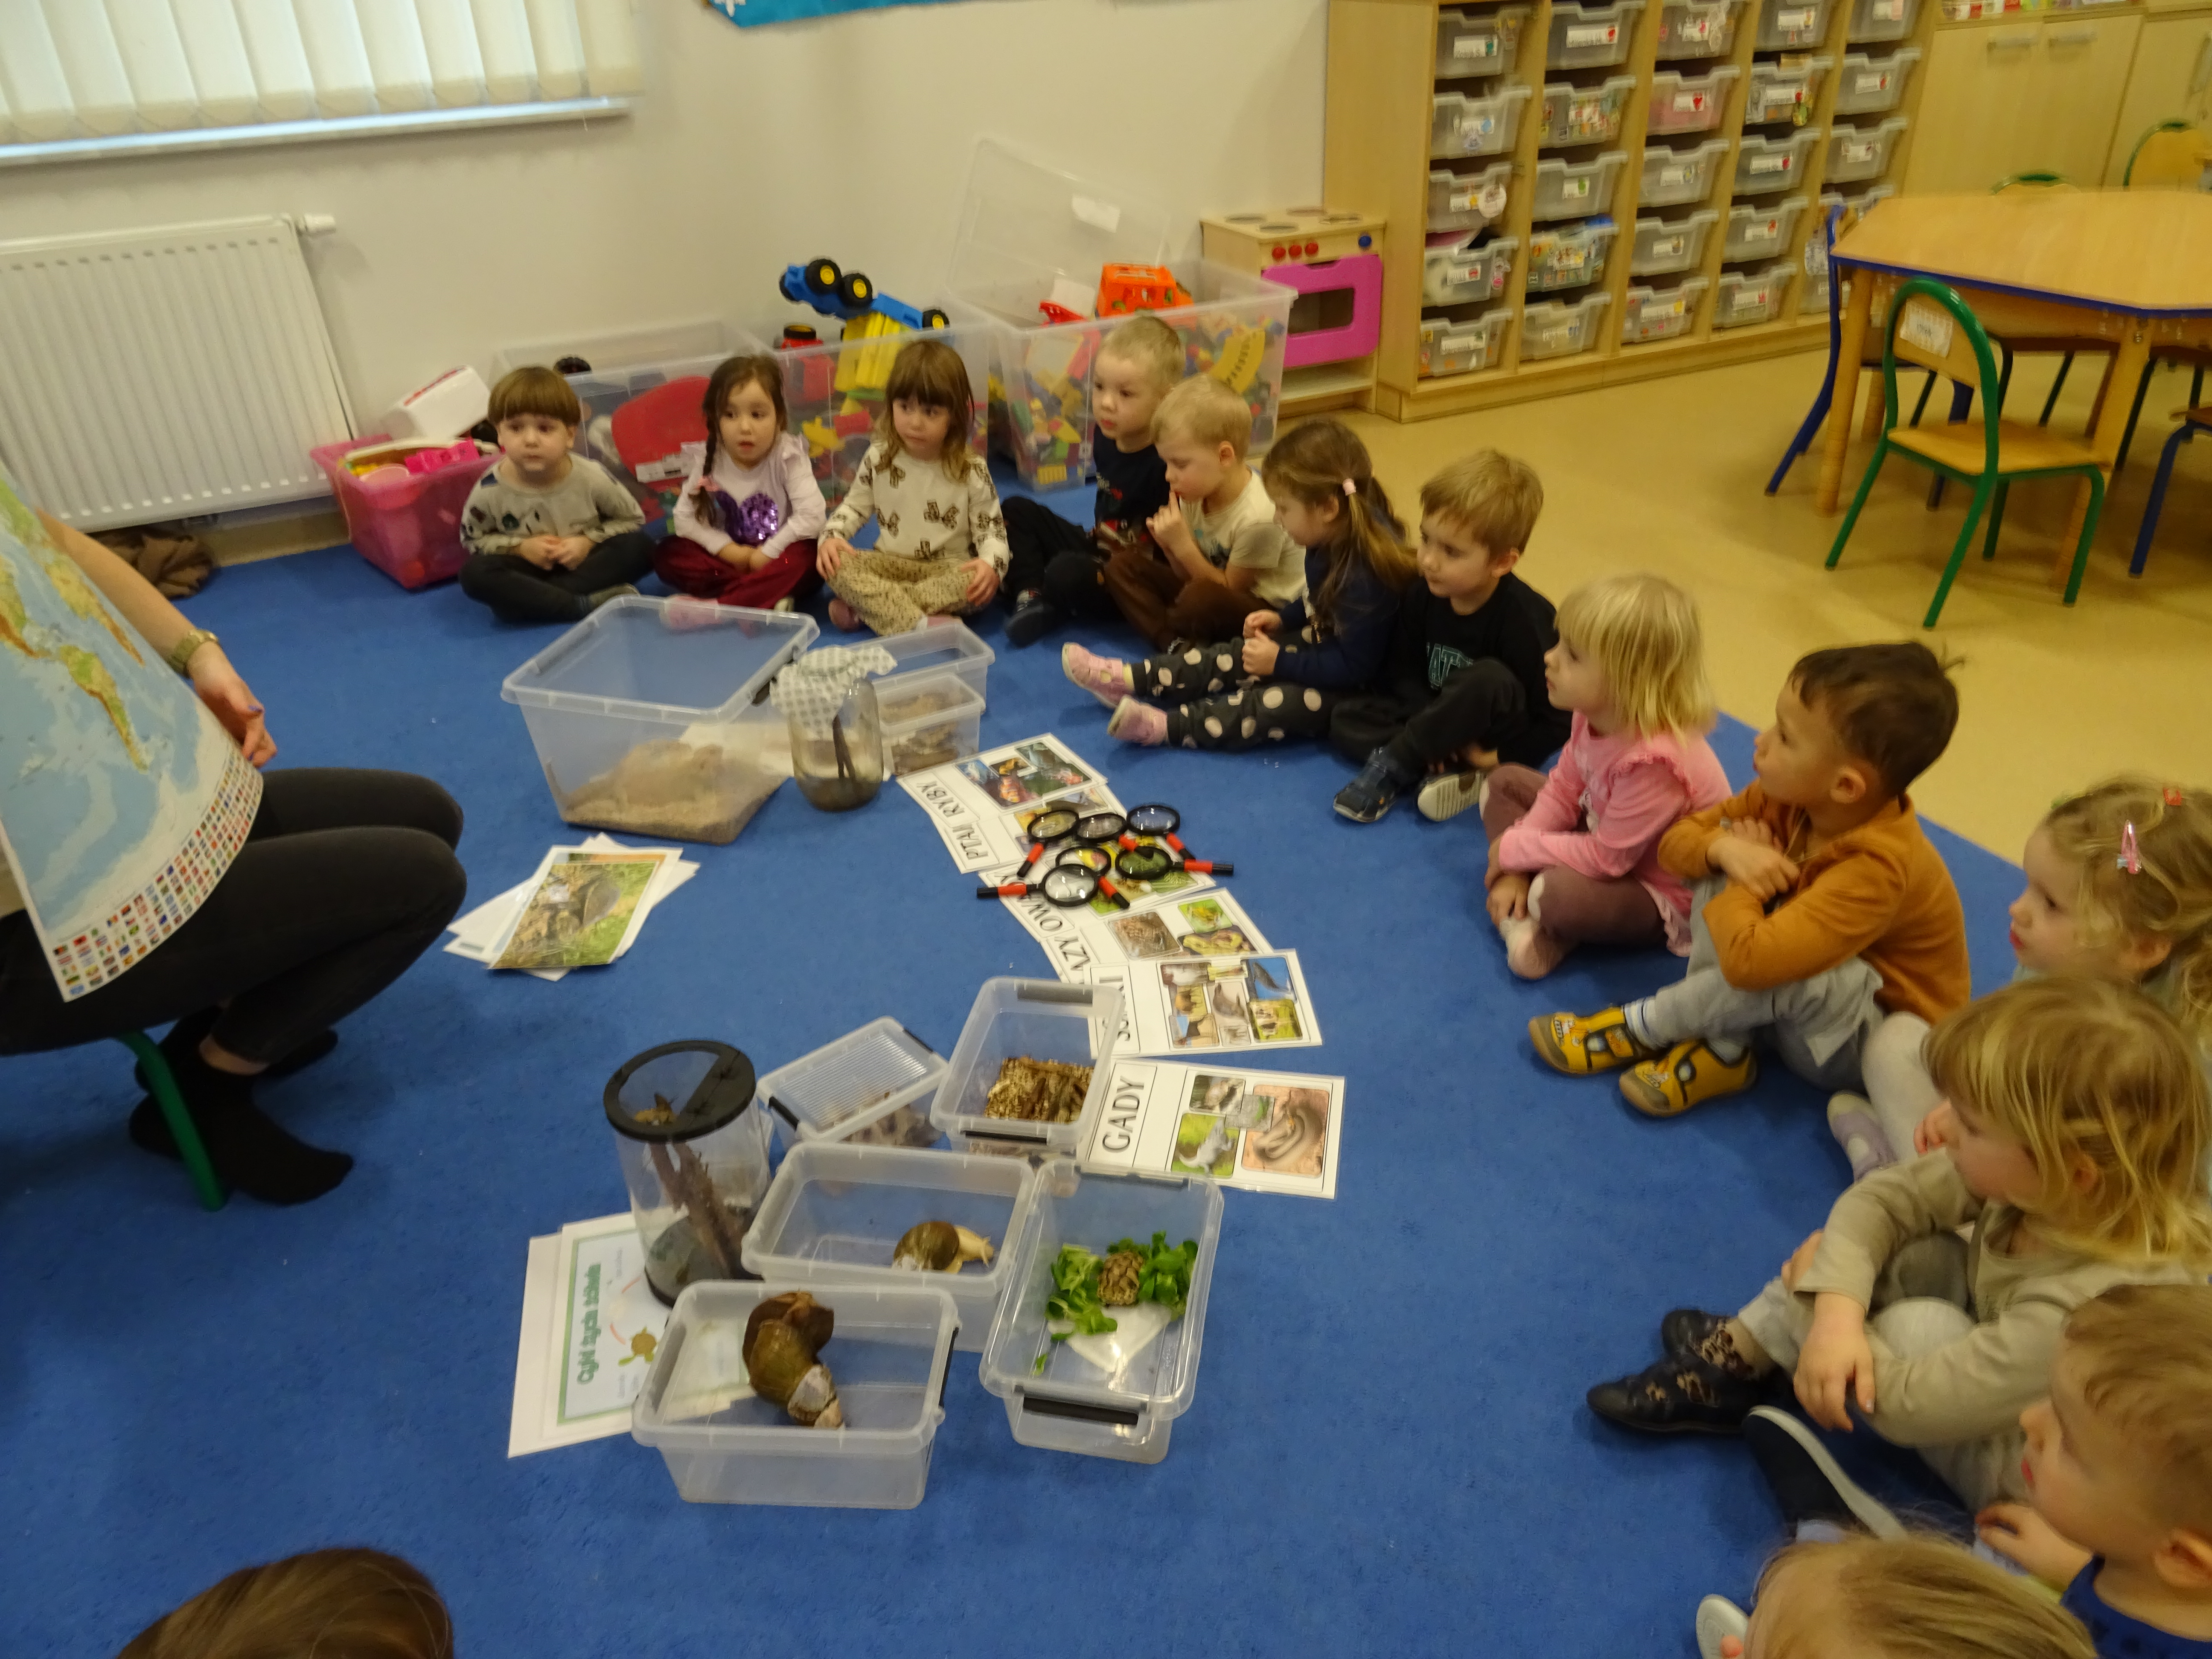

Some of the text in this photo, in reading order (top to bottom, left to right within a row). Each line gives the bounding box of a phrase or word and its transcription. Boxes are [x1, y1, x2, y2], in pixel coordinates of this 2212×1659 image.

[916, 780, 965, 818] RYBY
[952, 823, 988, 860] PTA
[1102, 1074, 1144, 1153] GADY
